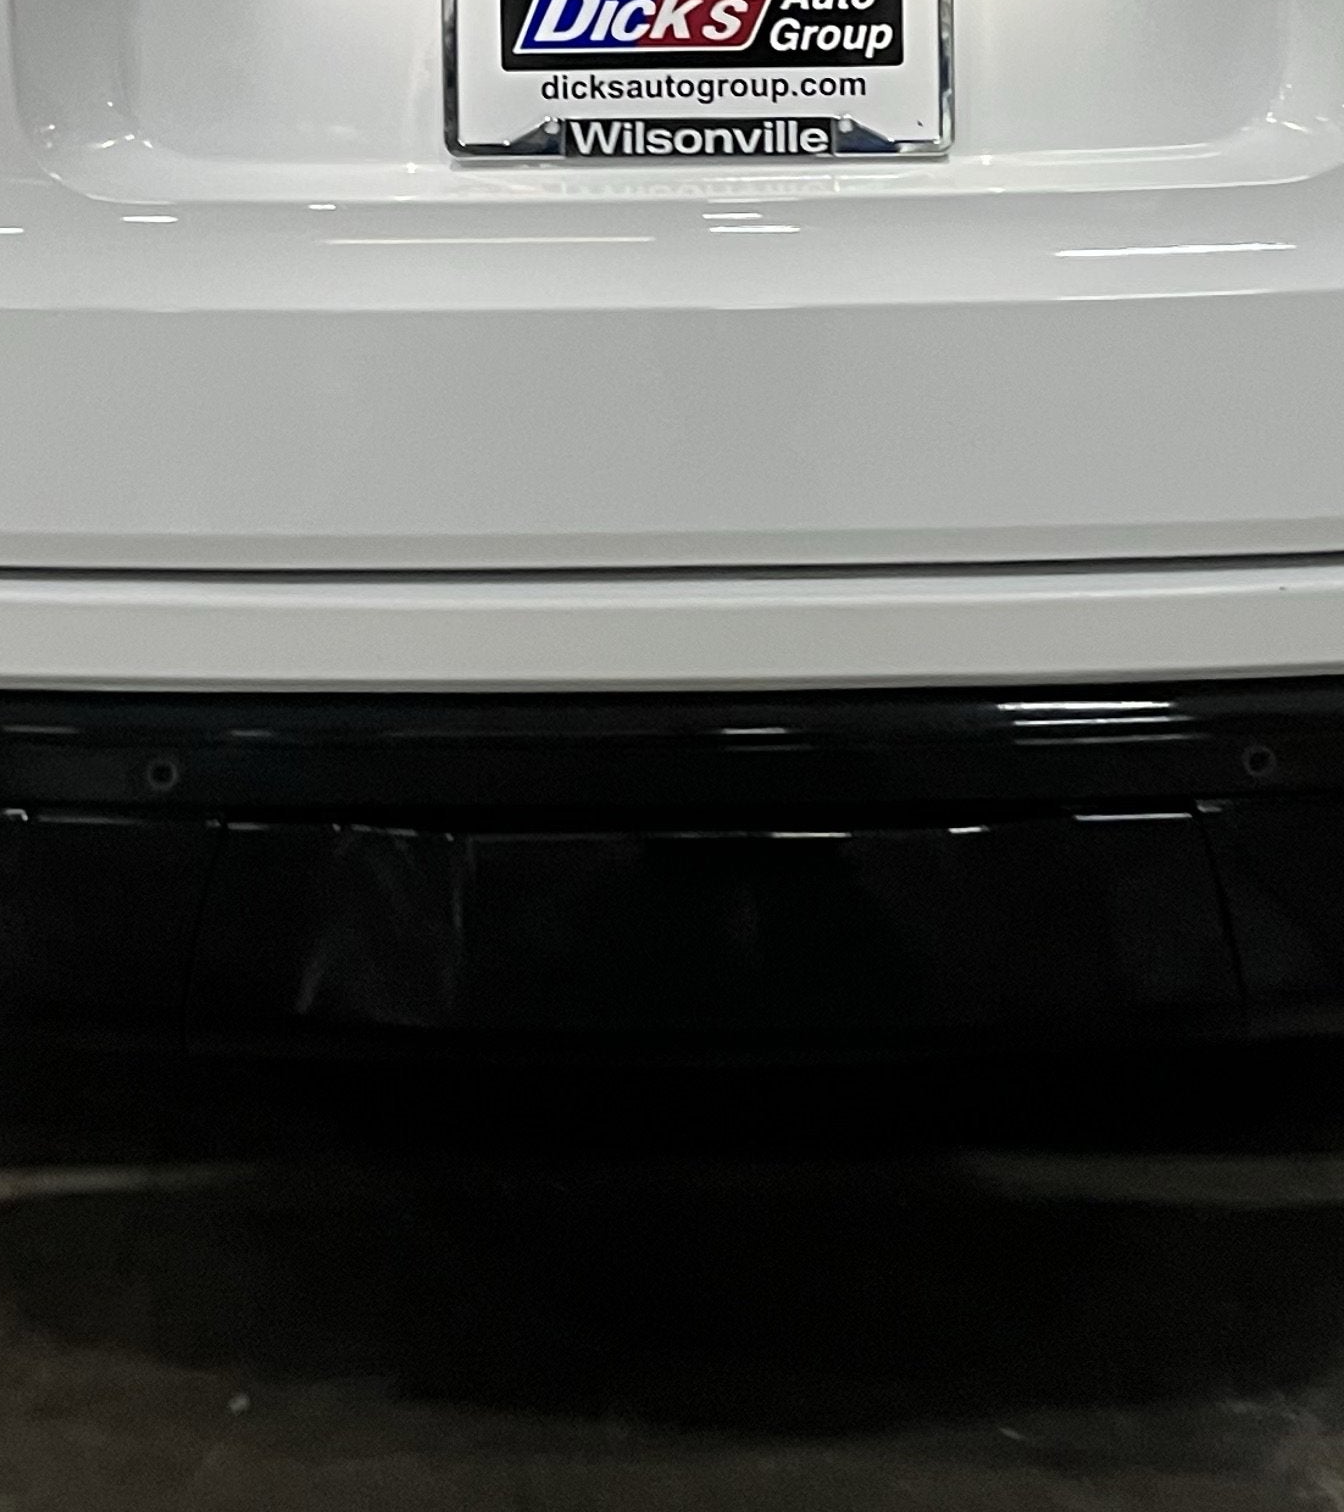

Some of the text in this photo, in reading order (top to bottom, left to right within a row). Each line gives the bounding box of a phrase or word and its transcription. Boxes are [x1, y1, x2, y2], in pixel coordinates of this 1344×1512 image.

[770, 19, 894, 58] Group
[541, 75, 867, 104] dicksautogroup.com
[570, 119, 830, 156] Wilsonville
